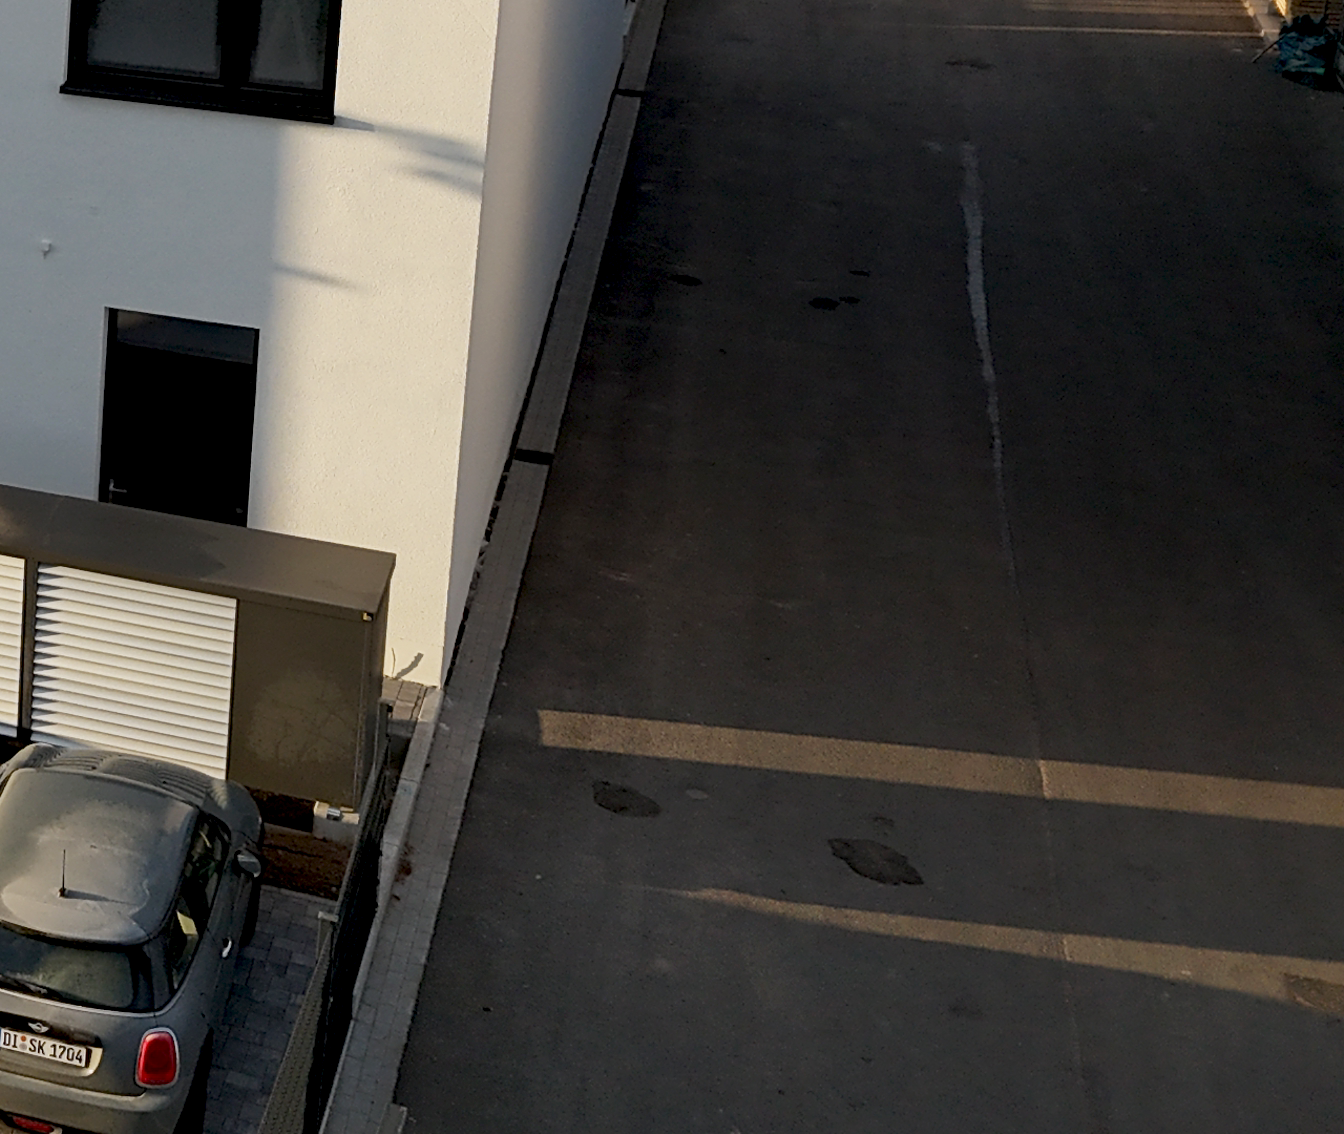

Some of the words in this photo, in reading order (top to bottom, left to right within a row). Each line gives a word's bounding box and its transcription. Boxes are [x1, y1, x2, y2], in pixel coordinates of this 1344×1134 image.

[3, 1031, 18, 1048] DI
[28, 1038, 46, 1055] SK
[49, 1043, 83, 1064] 1704
